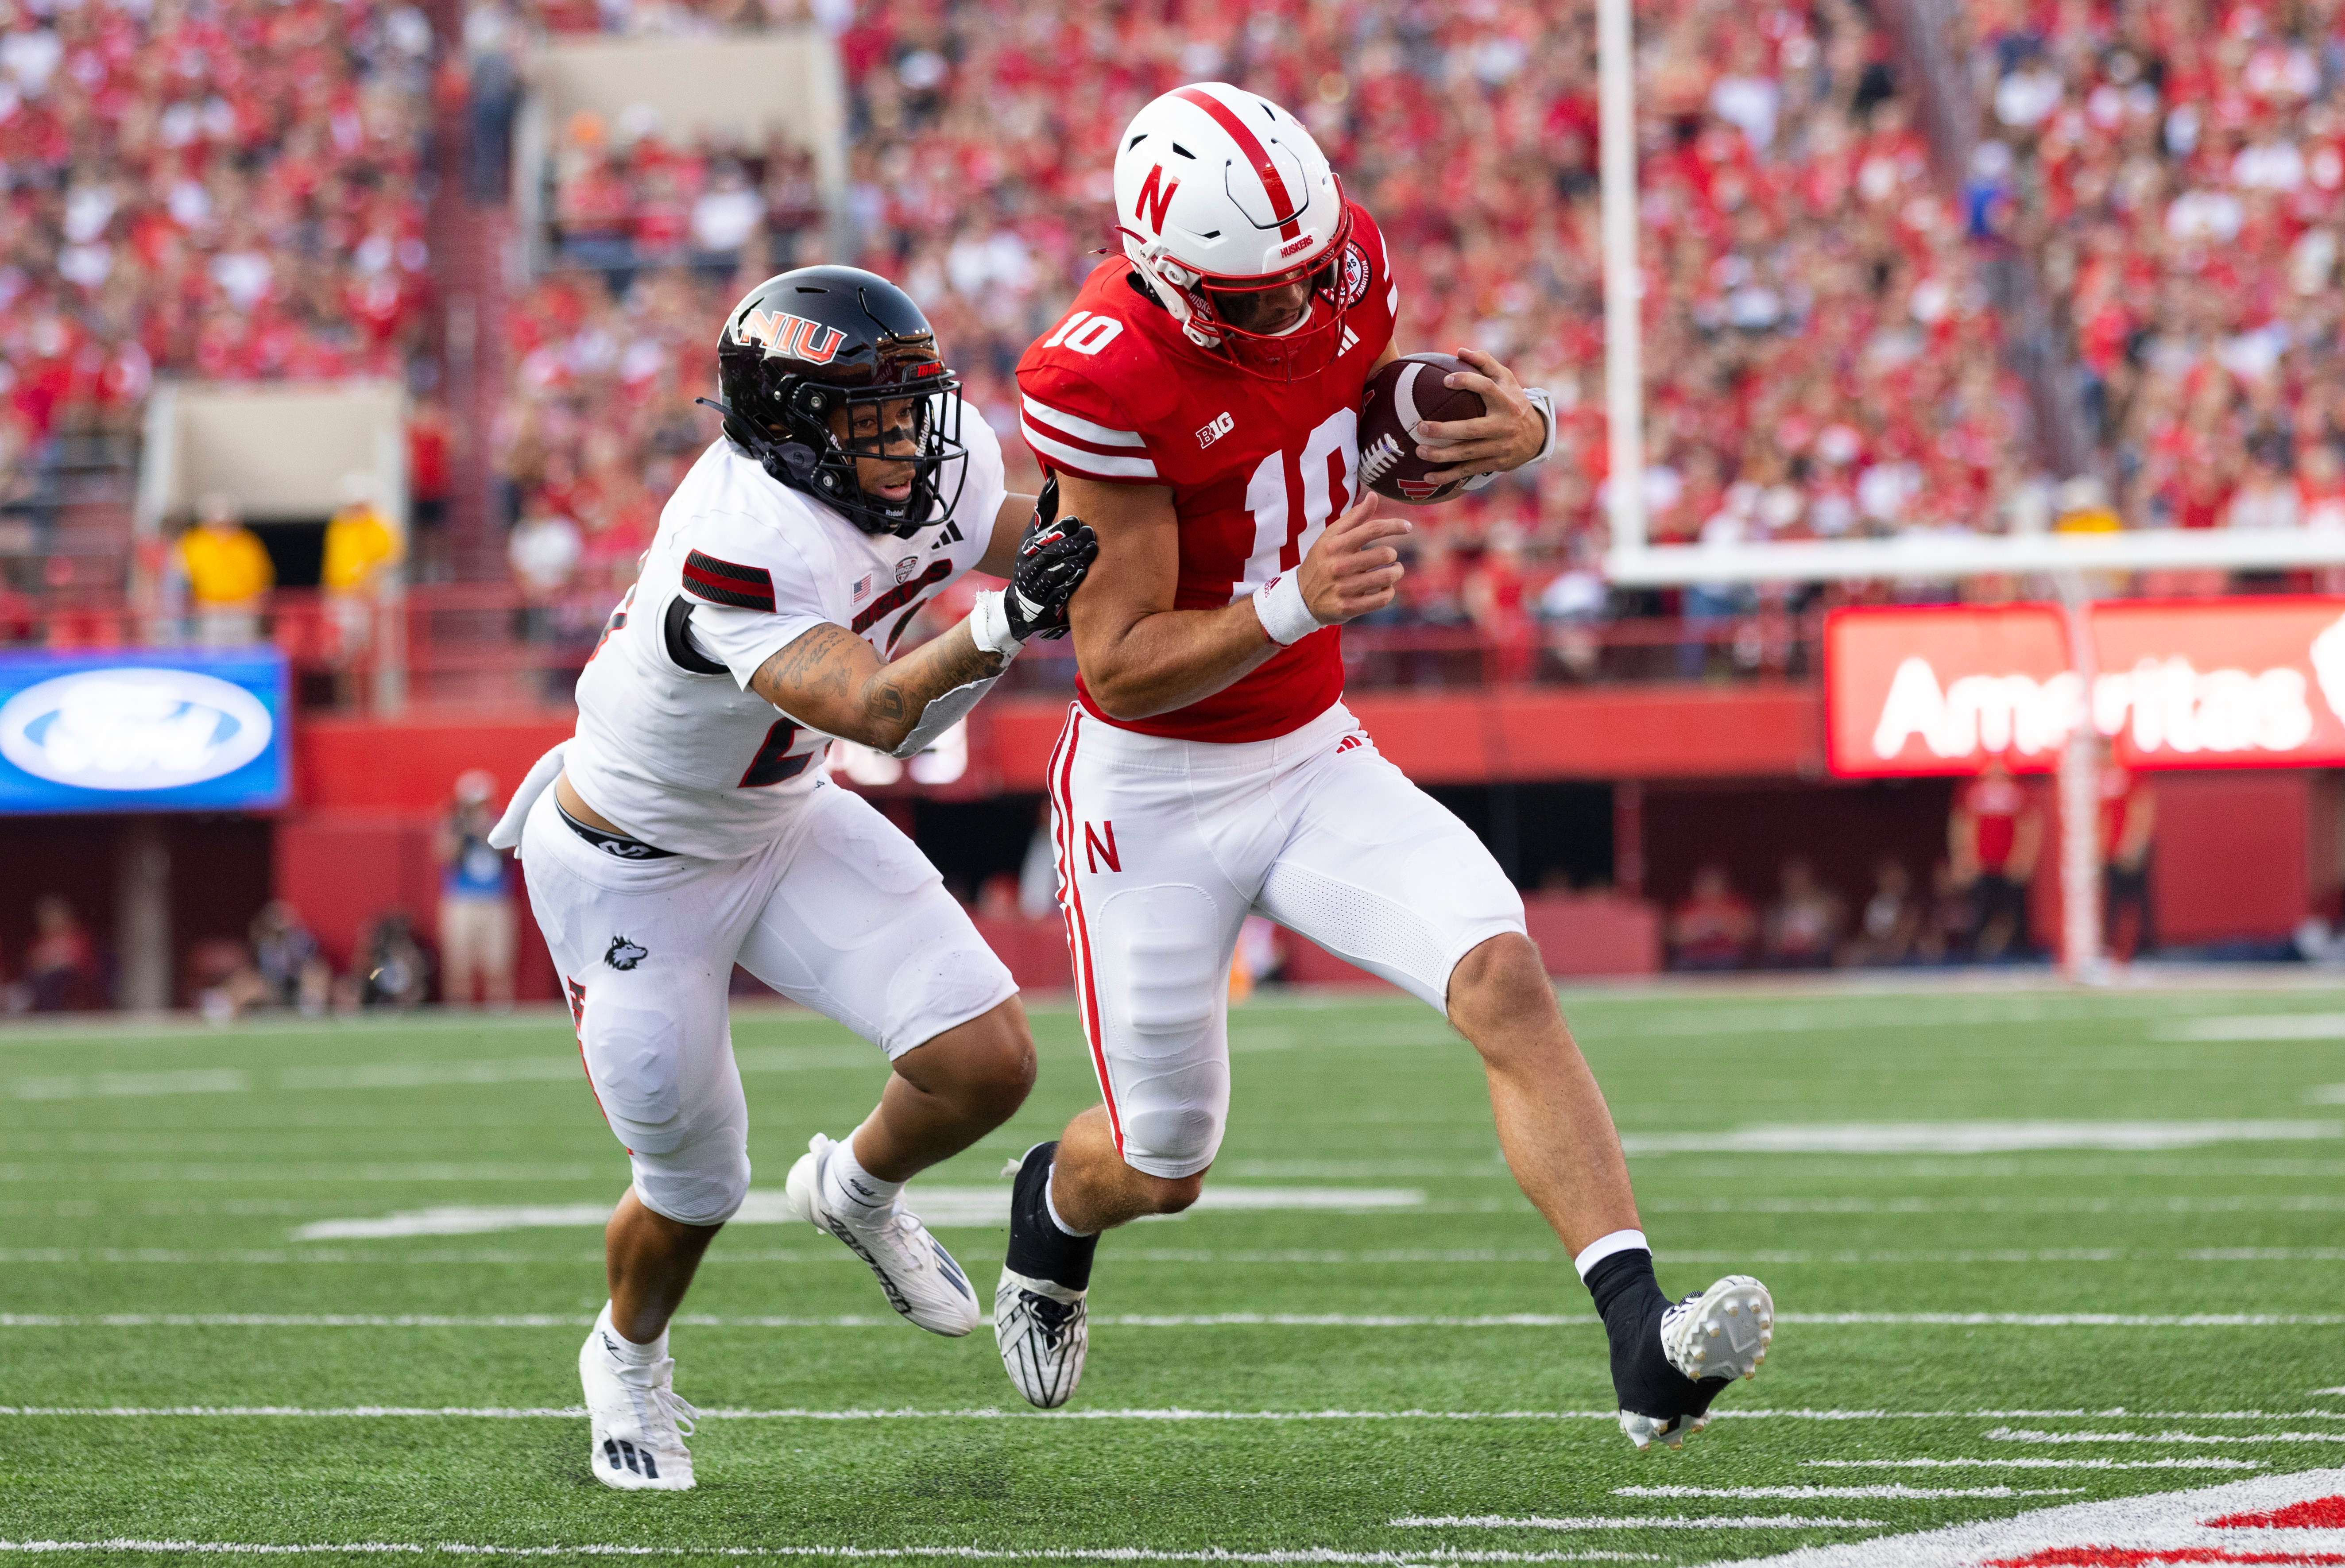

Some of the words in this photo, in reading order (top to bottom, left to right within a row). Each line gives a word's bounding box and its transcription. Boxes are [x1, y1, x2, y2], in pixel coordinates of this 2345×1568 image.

[1135, 161, 1181, 236] N
[1280, 235, 1314, 258] HUSKERS
[1356, 260, 1369, 298] TRADITION
[737, 308, 848, 366] NIU
[1042, 311, 1124, 356] 10
[1229, 407, 1360, 606] 10
[1085, 820, 1122, 874] N
